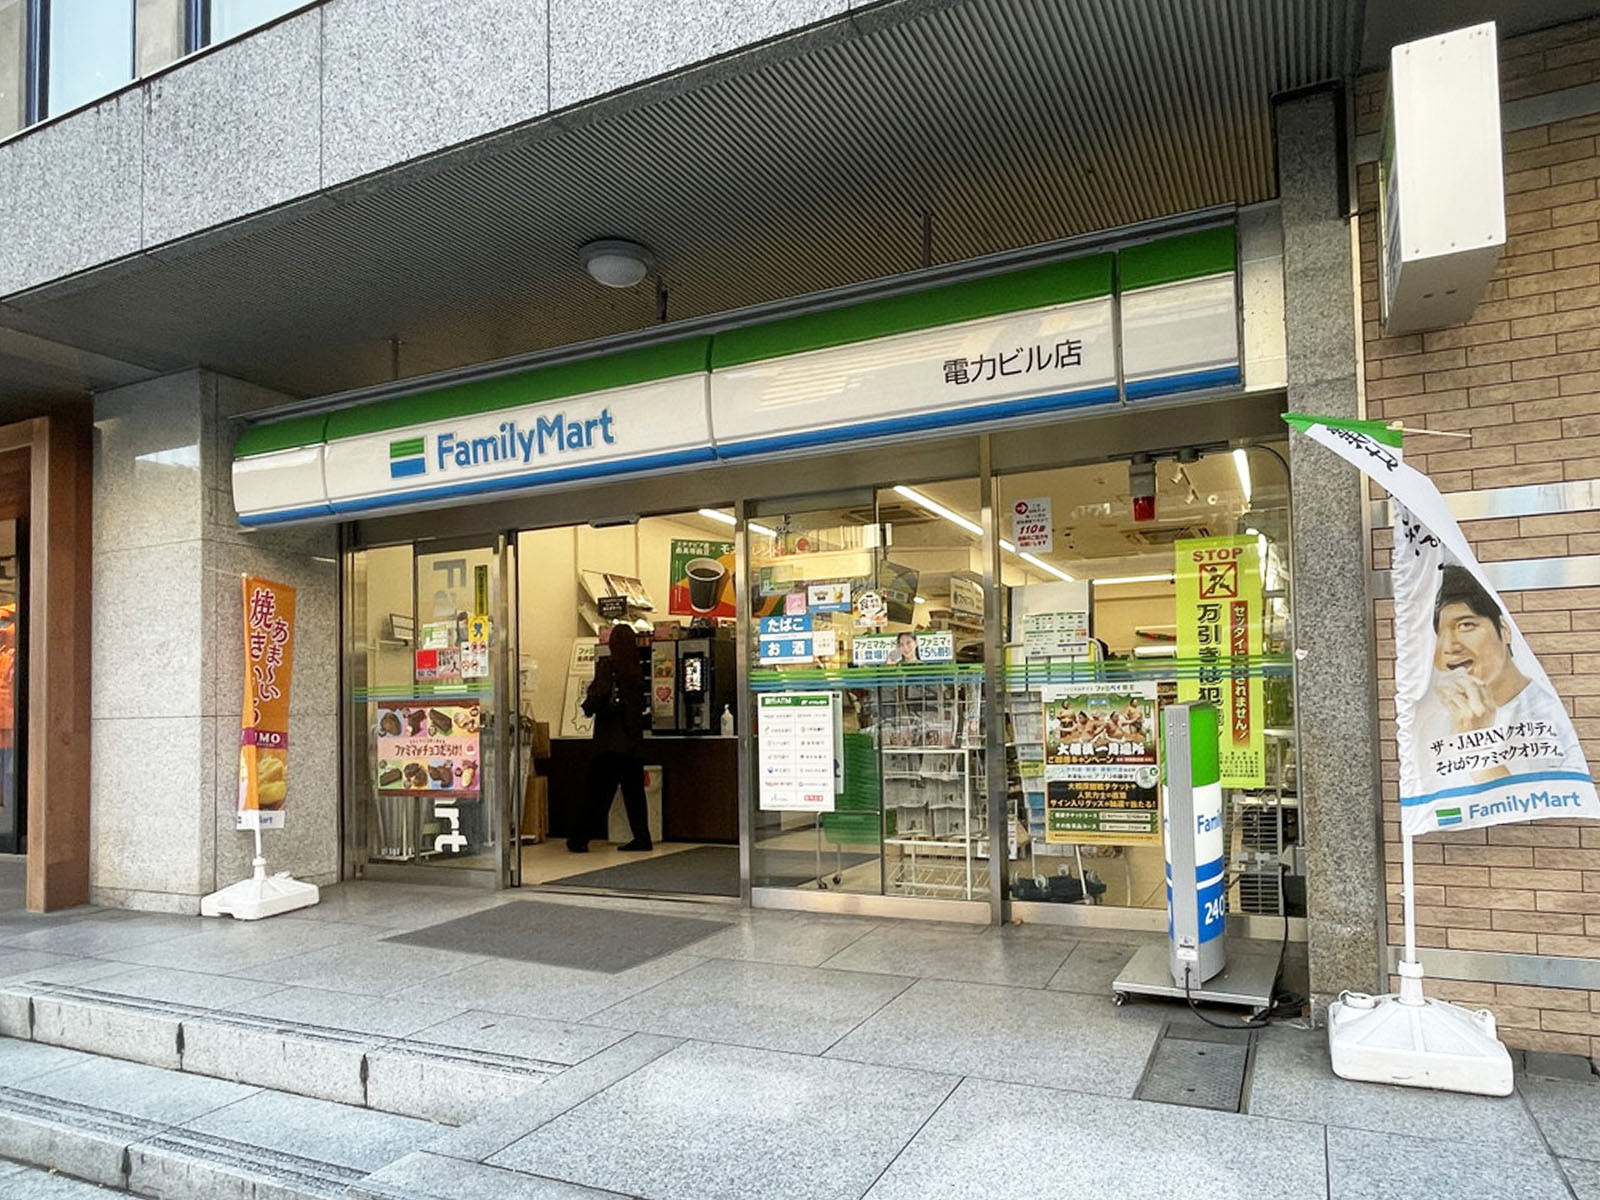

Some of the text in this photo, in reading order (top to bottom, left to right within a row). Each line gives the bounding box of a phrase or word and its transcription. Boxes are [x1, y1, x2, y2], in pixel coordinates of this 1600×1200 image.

[942, 339, 1082, 386] 電力ビル店
[437, 408, 616, 471] FamilyMart
[1193, 548, 1243, 562] STOP
[767, 617, 804, 632] たばこ
[1436, 742, 1564, 776] それがファミマクオリティ。
[1468, 791, 1582, 820] FamilyMart
